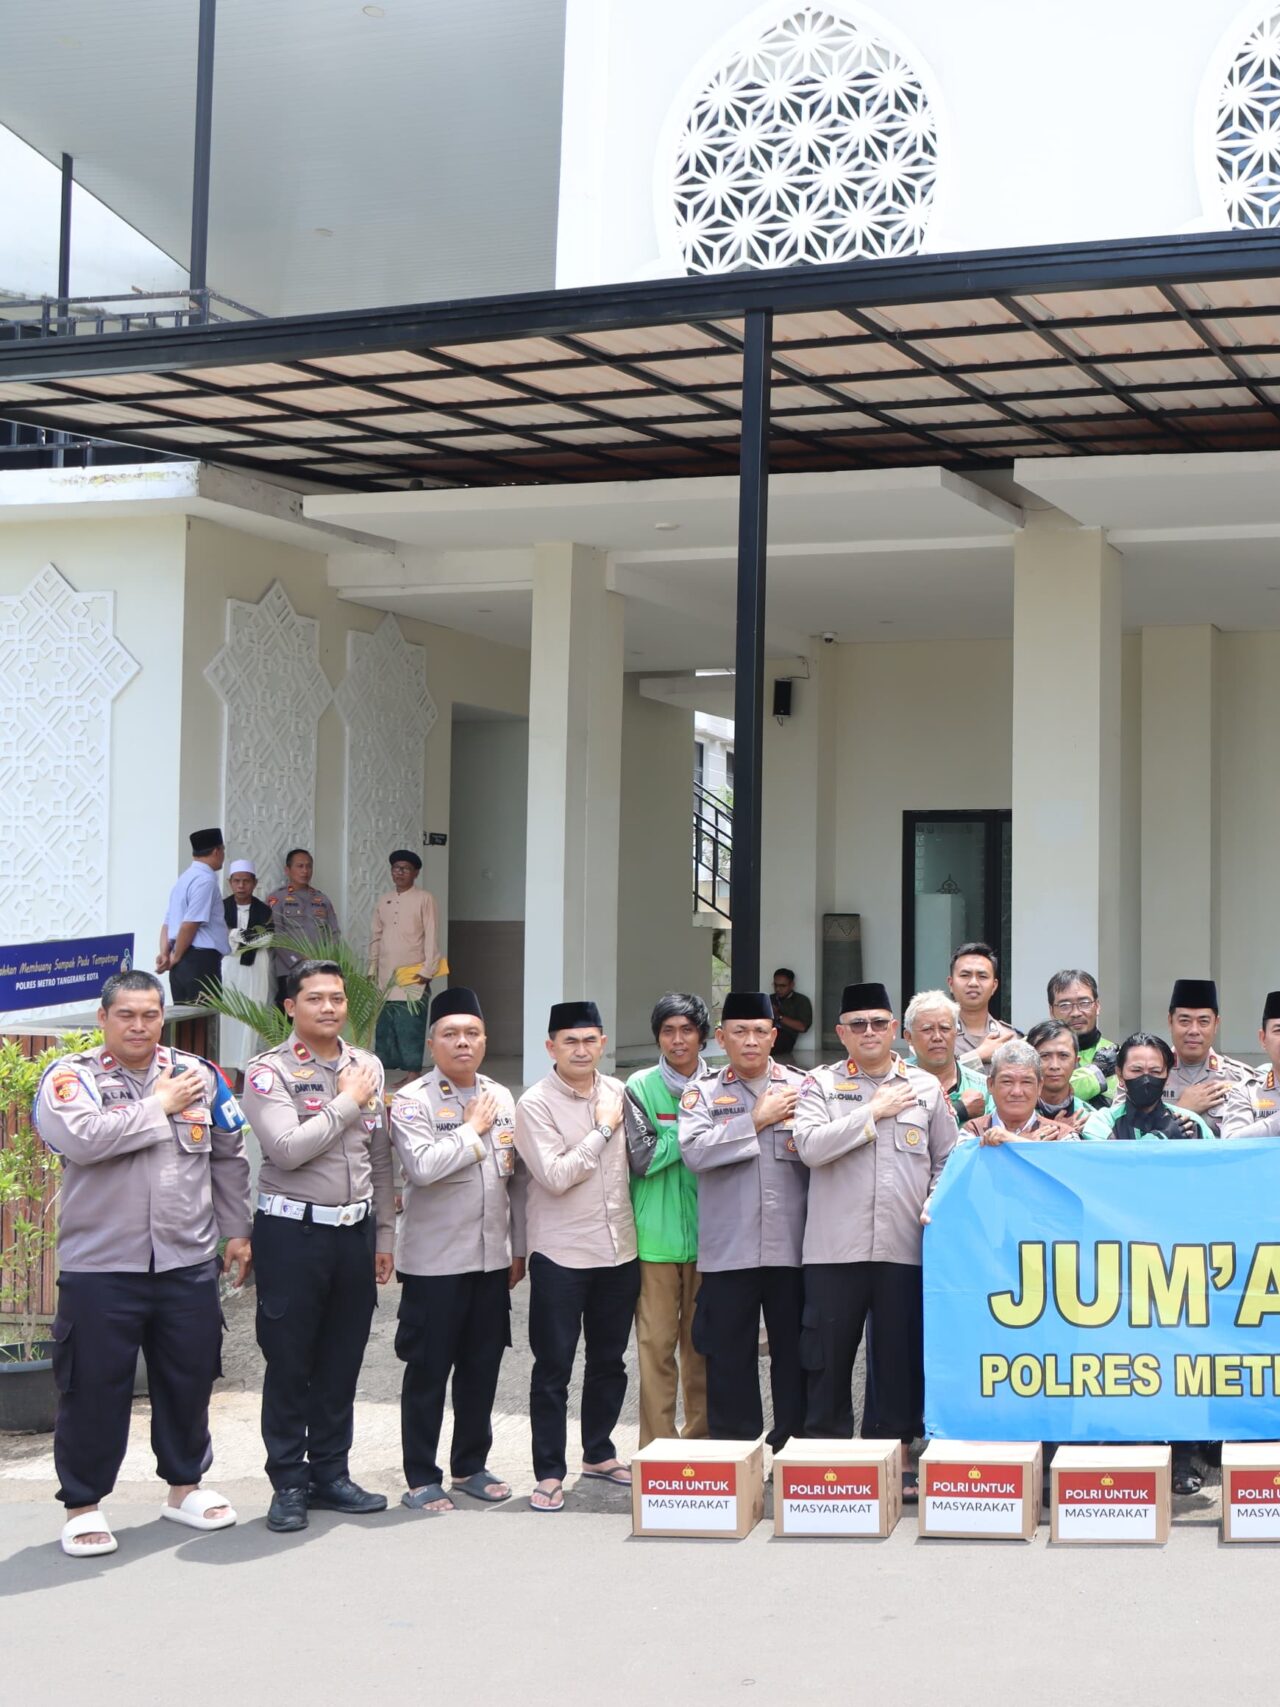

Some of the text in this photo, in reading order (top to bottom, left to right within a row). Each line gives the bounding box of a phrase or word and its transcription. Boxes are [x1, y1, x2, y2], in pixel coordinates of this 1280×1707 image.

[15, 972, 99, 991] POLRES METRO TANGERANG KOTA
[493, 1117, 513, 1127] OLRI
[979, 1353, 1162, 1398] POLRES
[648, 1480, 729, 1491] POLRI UNTUK
[789, 1484, 872, 1496] POLRI UNTUK
[932, 1481, 1016, 1494] POLRI UNTUK
[1065, 1488, 1149, 1500] POLRI UNTUK
[1237, 1488, 1274, 1500] POLRI
[648, 1499, 729, 1510] MASYARAKAT
[789, 1503, 872, 1514] MASYARAKAT
[932, 1501, 1016, 1512] MASYARAKAT
[1065, 1507, 1149, 1518] MASYARAKAT
